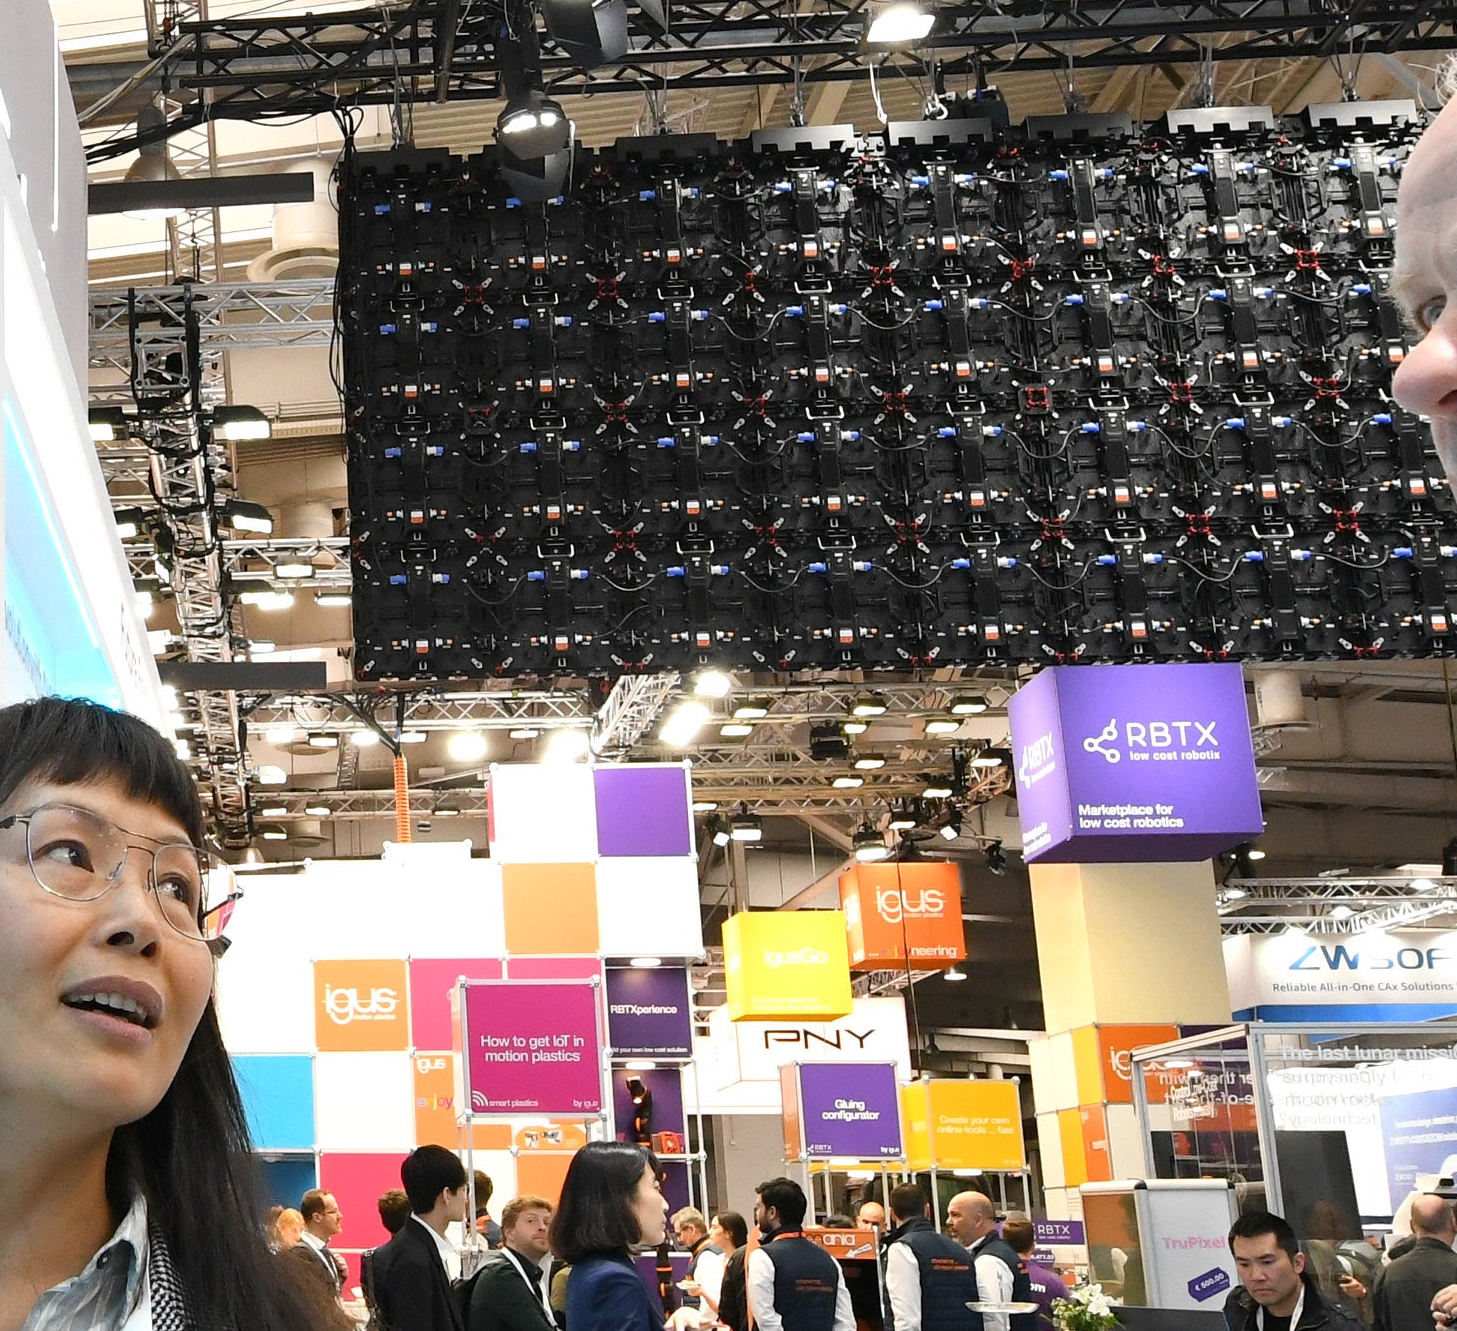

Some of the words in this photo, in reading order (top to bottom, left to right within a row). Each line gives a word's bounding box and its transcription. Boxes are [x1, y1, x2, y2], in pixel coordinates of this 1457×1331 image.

[1125, 721, 1219, 748] RBTX
[1129, 750, 1149, 761] low
[1153, 751, 1178, 761] cost
[1078, 803, 1154, 819] Marketplace
[1155, 803, 1174, 816] for
[1079, 817, 1102, 829] low
[1103, 818, 1132, 829] cost
[1133, 816, 1184, 829] robotics
[874, 885, 946, 923] igus
[1272, 981, 1317, 993] Reliable
[1319, 981, 1375, 993] All-in-One
[1377, 981, 1398, 992] CAx
[1401, 980, 1454, 992] Solutions
[324, 983, 398, 1025] igus
[610, 1004, 678, 1016] RBTXperience
[480, 1034, 510, 1048] How
[512, 1035, 527, 1048] to
[529, 1035, 551, 1051] get
[552, 1034, 571, 1048] IoT
[573, 1034, 585, 1048] in
[764, 1028, 875, 1050] PNY
[485, 1049, 529, 1063] motion
[531, 1049, 581, 1065] plastics
[1280, 1045, 1313, 1061] The
[1317, 1045, 1351, 1061] last
[1354, 1045, 1401, 1061] lunar
[489, 1100, 510, 1108] smart
[511, 1098, 539, 1110] plastics
[573, 1099, 583, 1109] by
[834, 1098, 866, 1112] Gluing
[822, 1109, 881, 1123] configurator
[939, 1115, 970, 1125] Create
[970, 1116, 990, 1127] your
[991, 1117, 1011, 1125] own
[1037, 1224, 1071, 1235] RBTX
[1162, 1235, 1227, 1250] TruPixel
